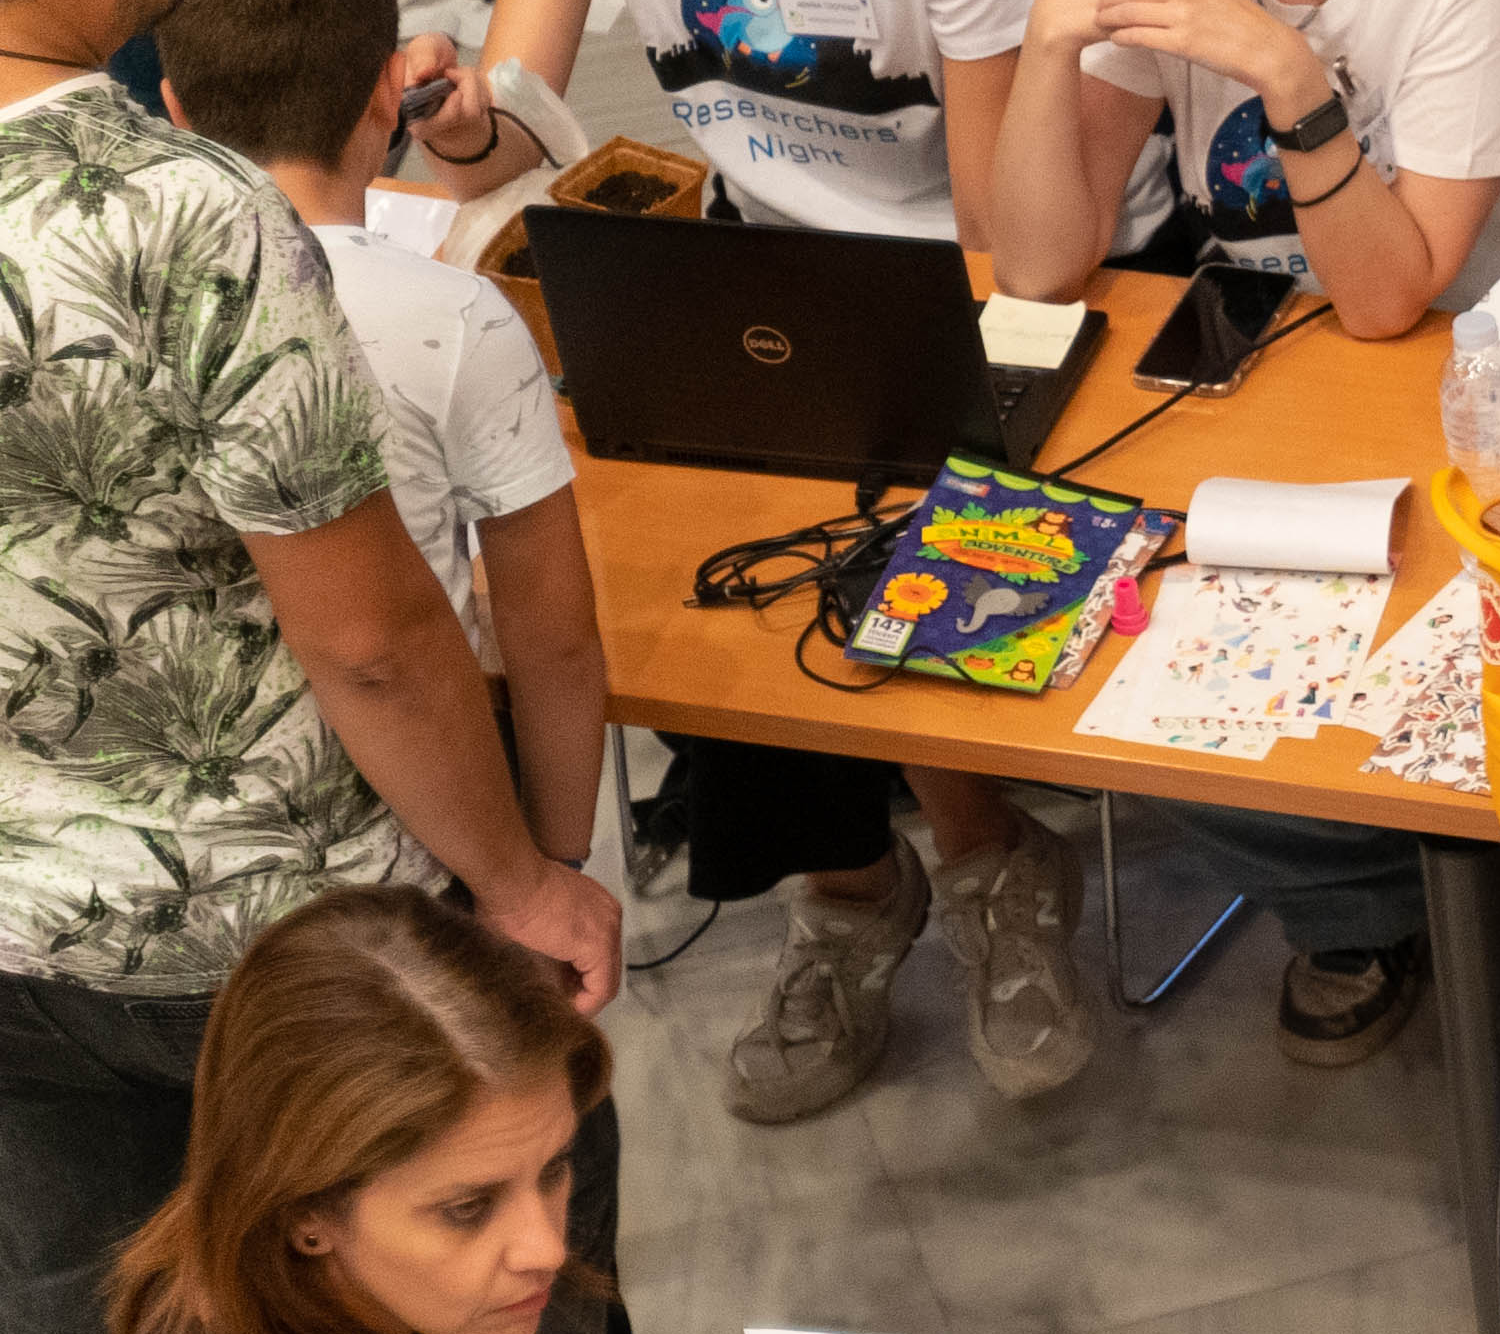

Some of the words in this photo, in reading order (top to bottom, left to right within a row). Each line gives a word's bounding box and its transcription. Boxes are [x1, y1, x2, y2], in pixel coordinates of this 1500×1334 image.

[672, 98, 902, 143] Researchers'
[747, 134, 850, 166] Night
[748, 338, 785, 351] DELL
[871, 617, 906, 635] 142
